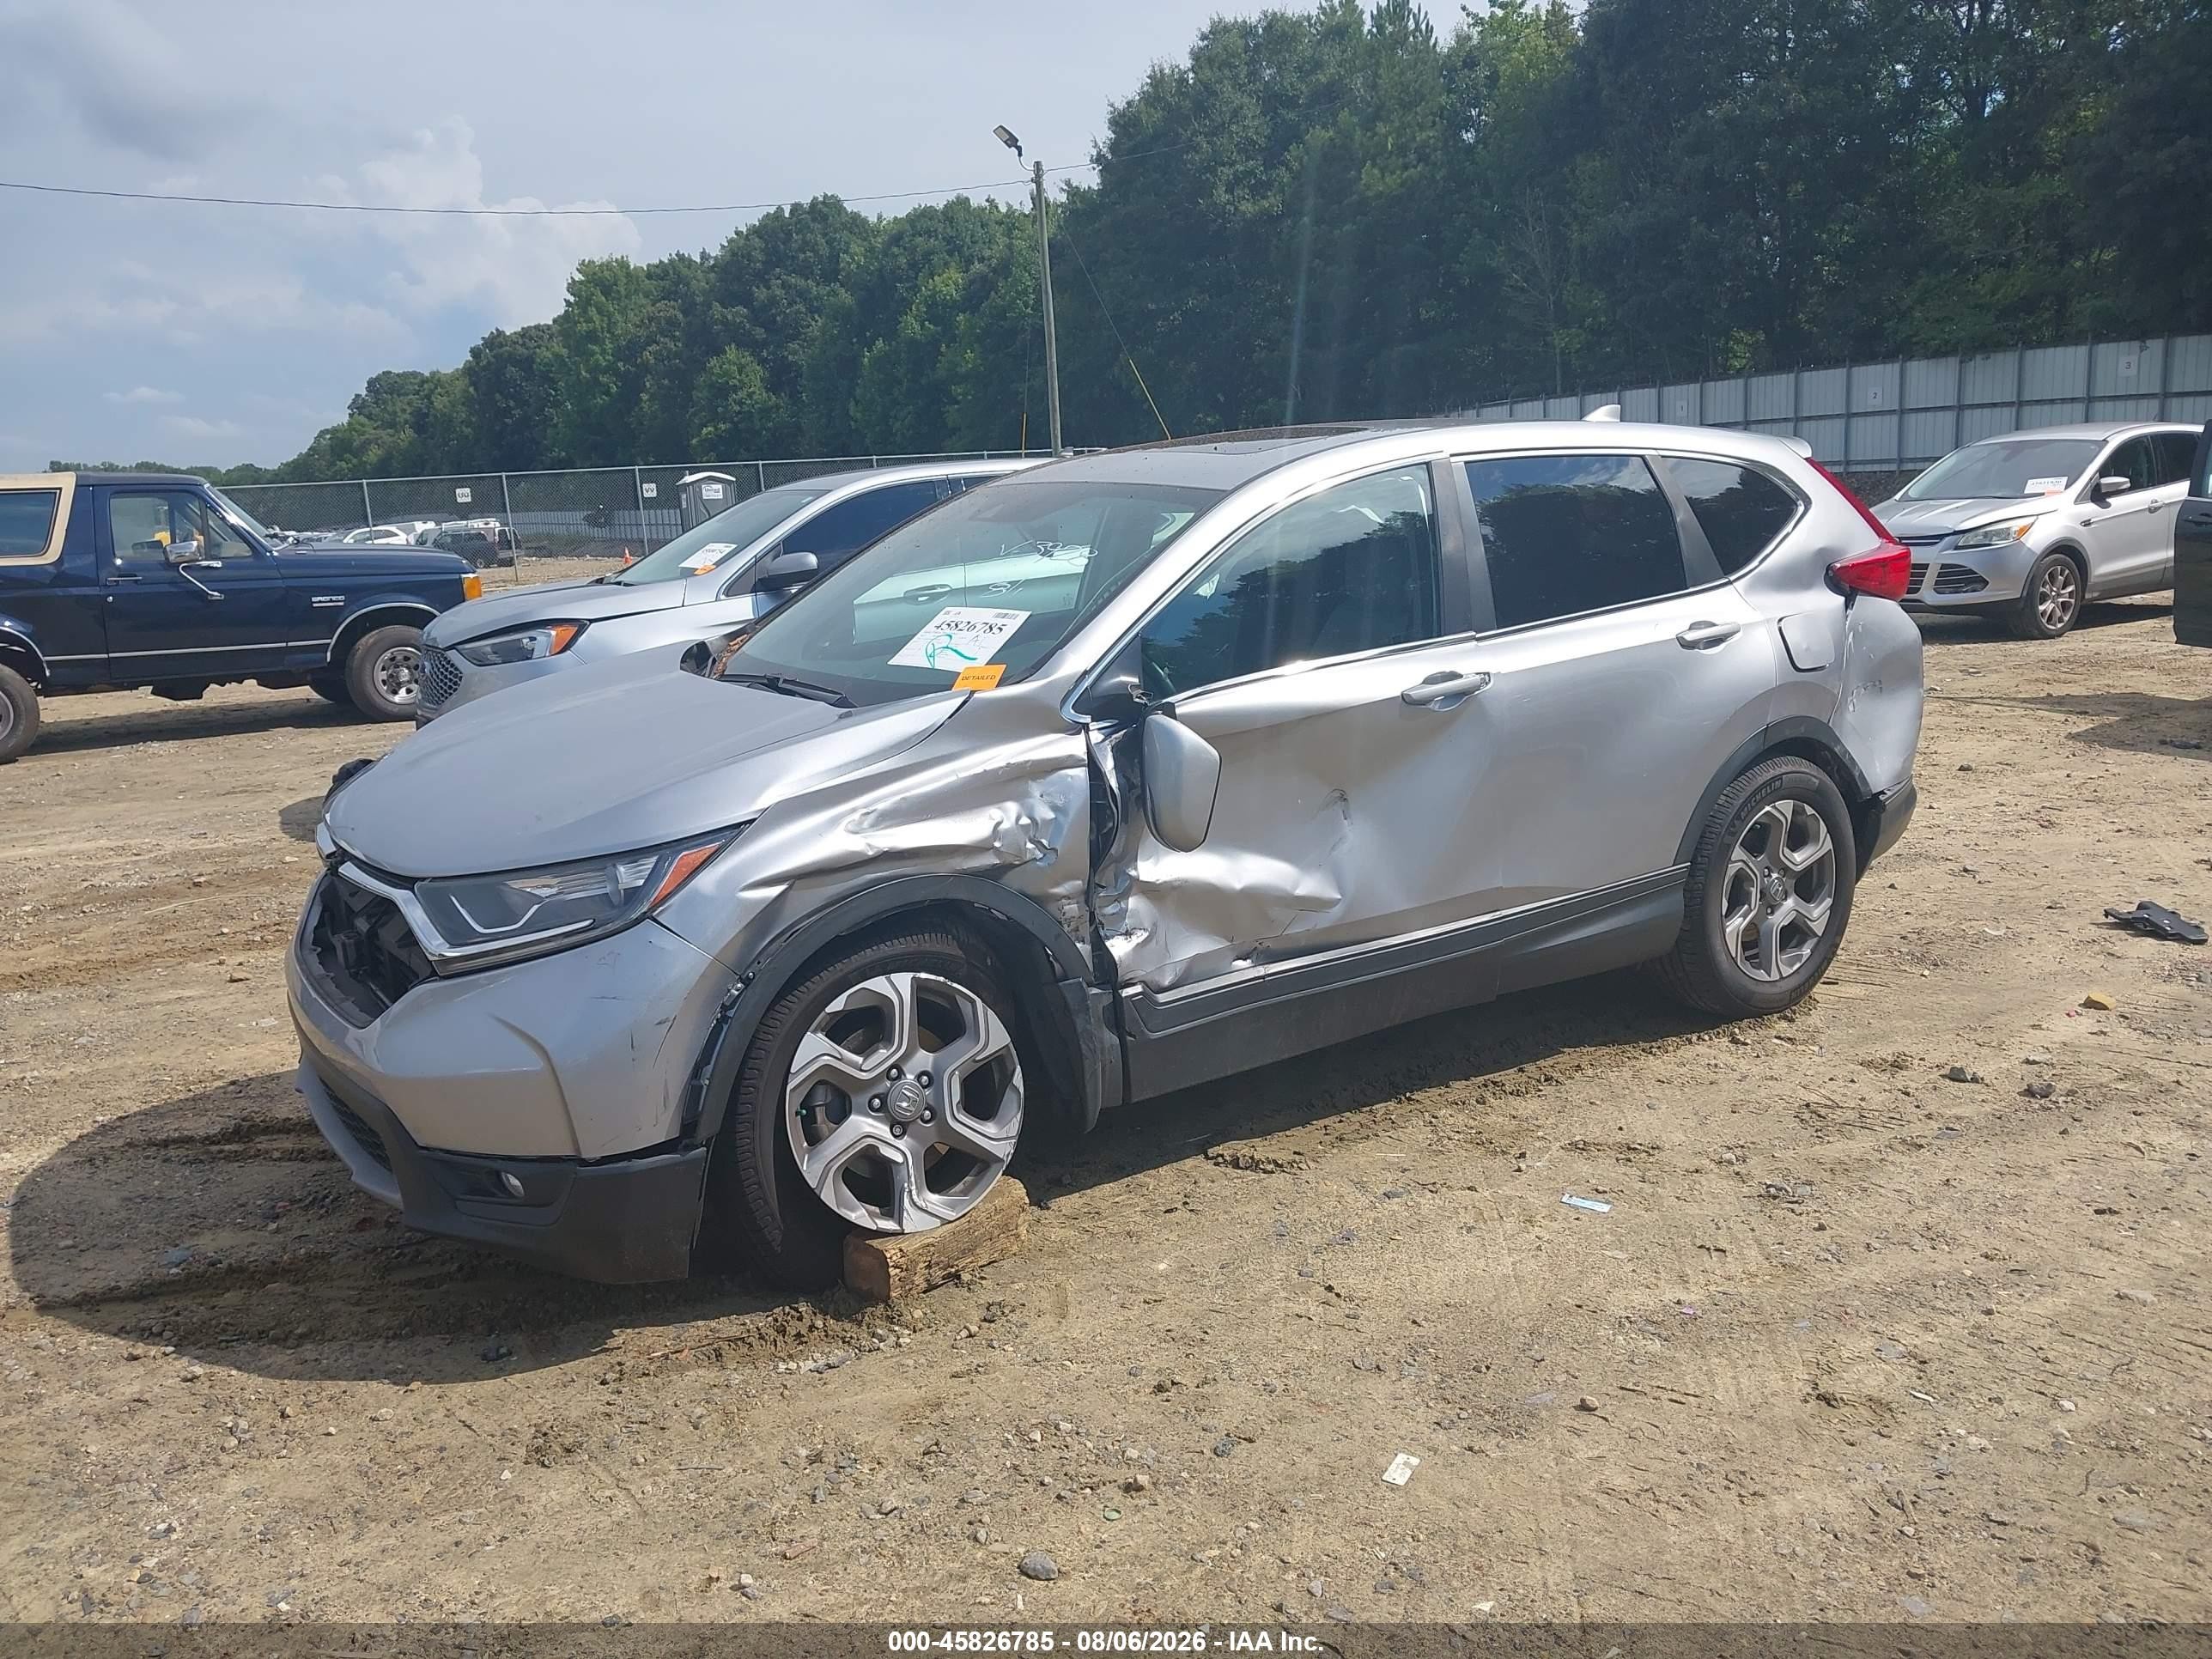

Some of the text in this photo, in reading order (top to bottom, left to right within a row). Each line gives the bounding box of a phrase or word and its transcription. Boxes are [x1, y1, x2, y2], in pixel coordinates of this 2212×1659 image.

[2125, 361, 2131, 370] 3
[933, 620, 1008, 635] 45826785
[1740, 776, 1784, 820] MICHELIN
